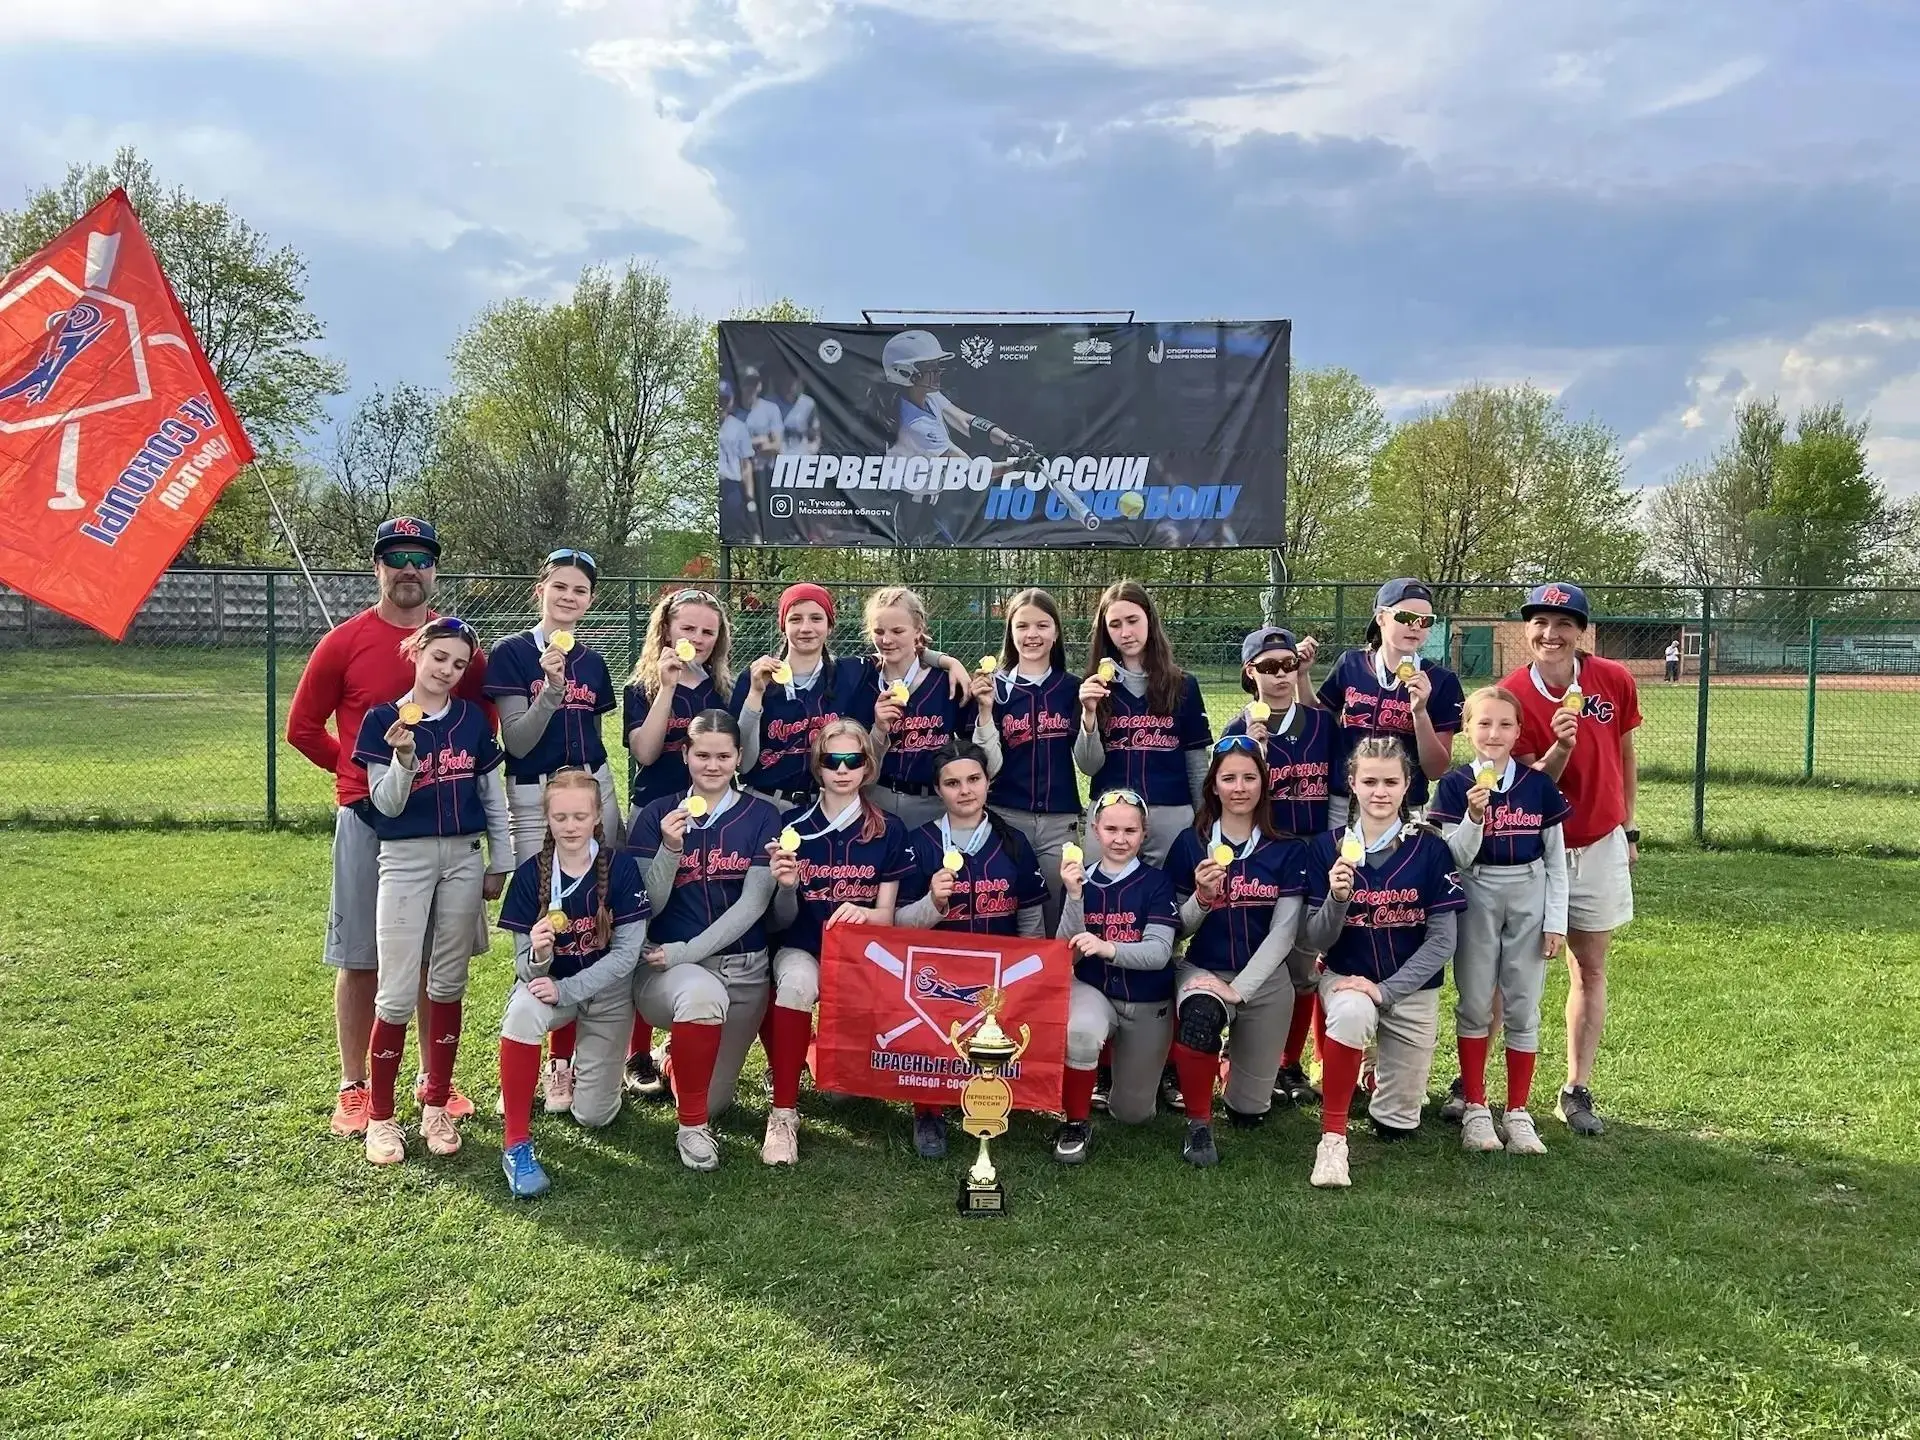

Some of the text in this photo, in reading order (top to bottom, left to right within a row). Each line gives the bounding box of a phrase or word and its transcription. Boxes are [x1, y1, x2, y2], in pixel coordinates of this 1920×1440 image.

[999, 353, 1029, 361] РОССИИ
[770, 454, 993, 492] ПЕРВЕНСТВО
[799, 507, 891, 516] Московская область
[809, 499, 846, 508] Тучково
[984, 485, 1035, 521] ПО
[1105, 715, 1174, 737] расные
[871, 1050, 949, 1074] КРАСНЫЕ
[898, 1074, 940, 1088] БЕЙСБОЛ
